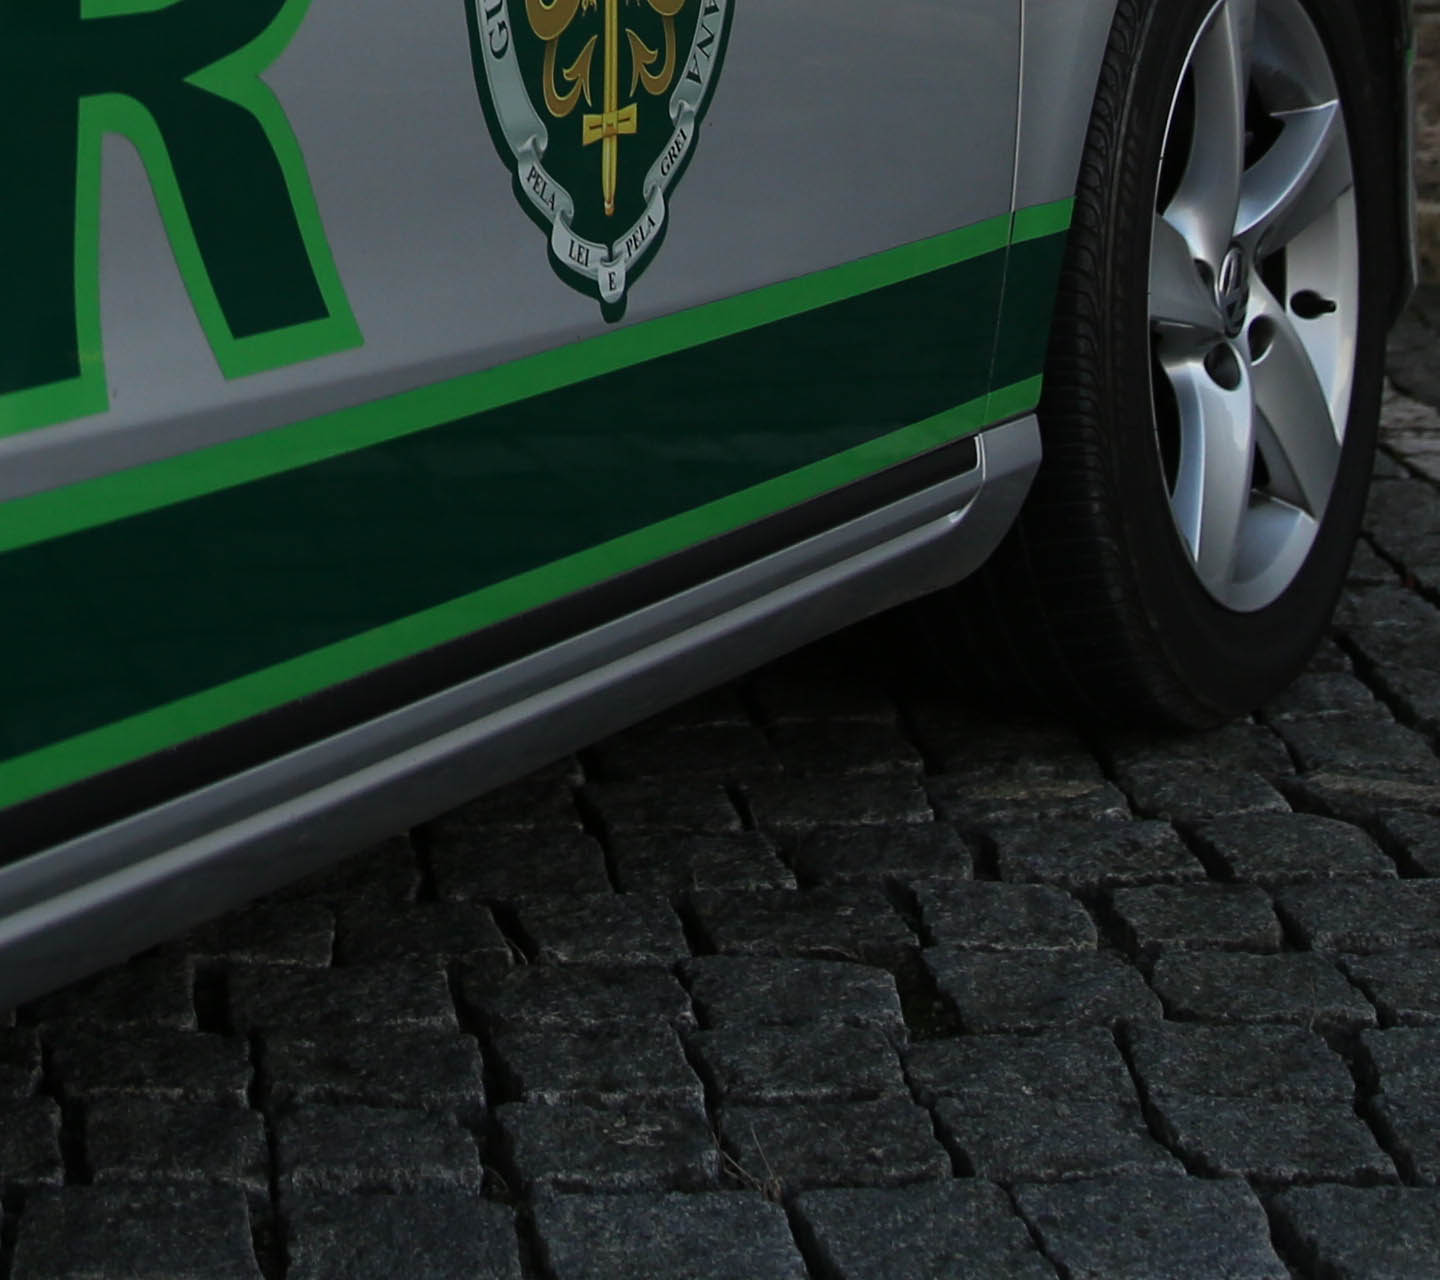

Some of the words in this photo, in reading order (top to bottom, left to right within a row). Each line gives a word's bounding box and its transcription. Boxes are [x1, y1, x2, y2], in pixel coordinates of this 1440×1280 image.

[526, 165, 557, 212] PELA
[568, 239, 590, 268] LEI
[608, 271, 618, 291] E
[625, 214, 656, 258] PELA
[659, 127, 688, 177] GREI
